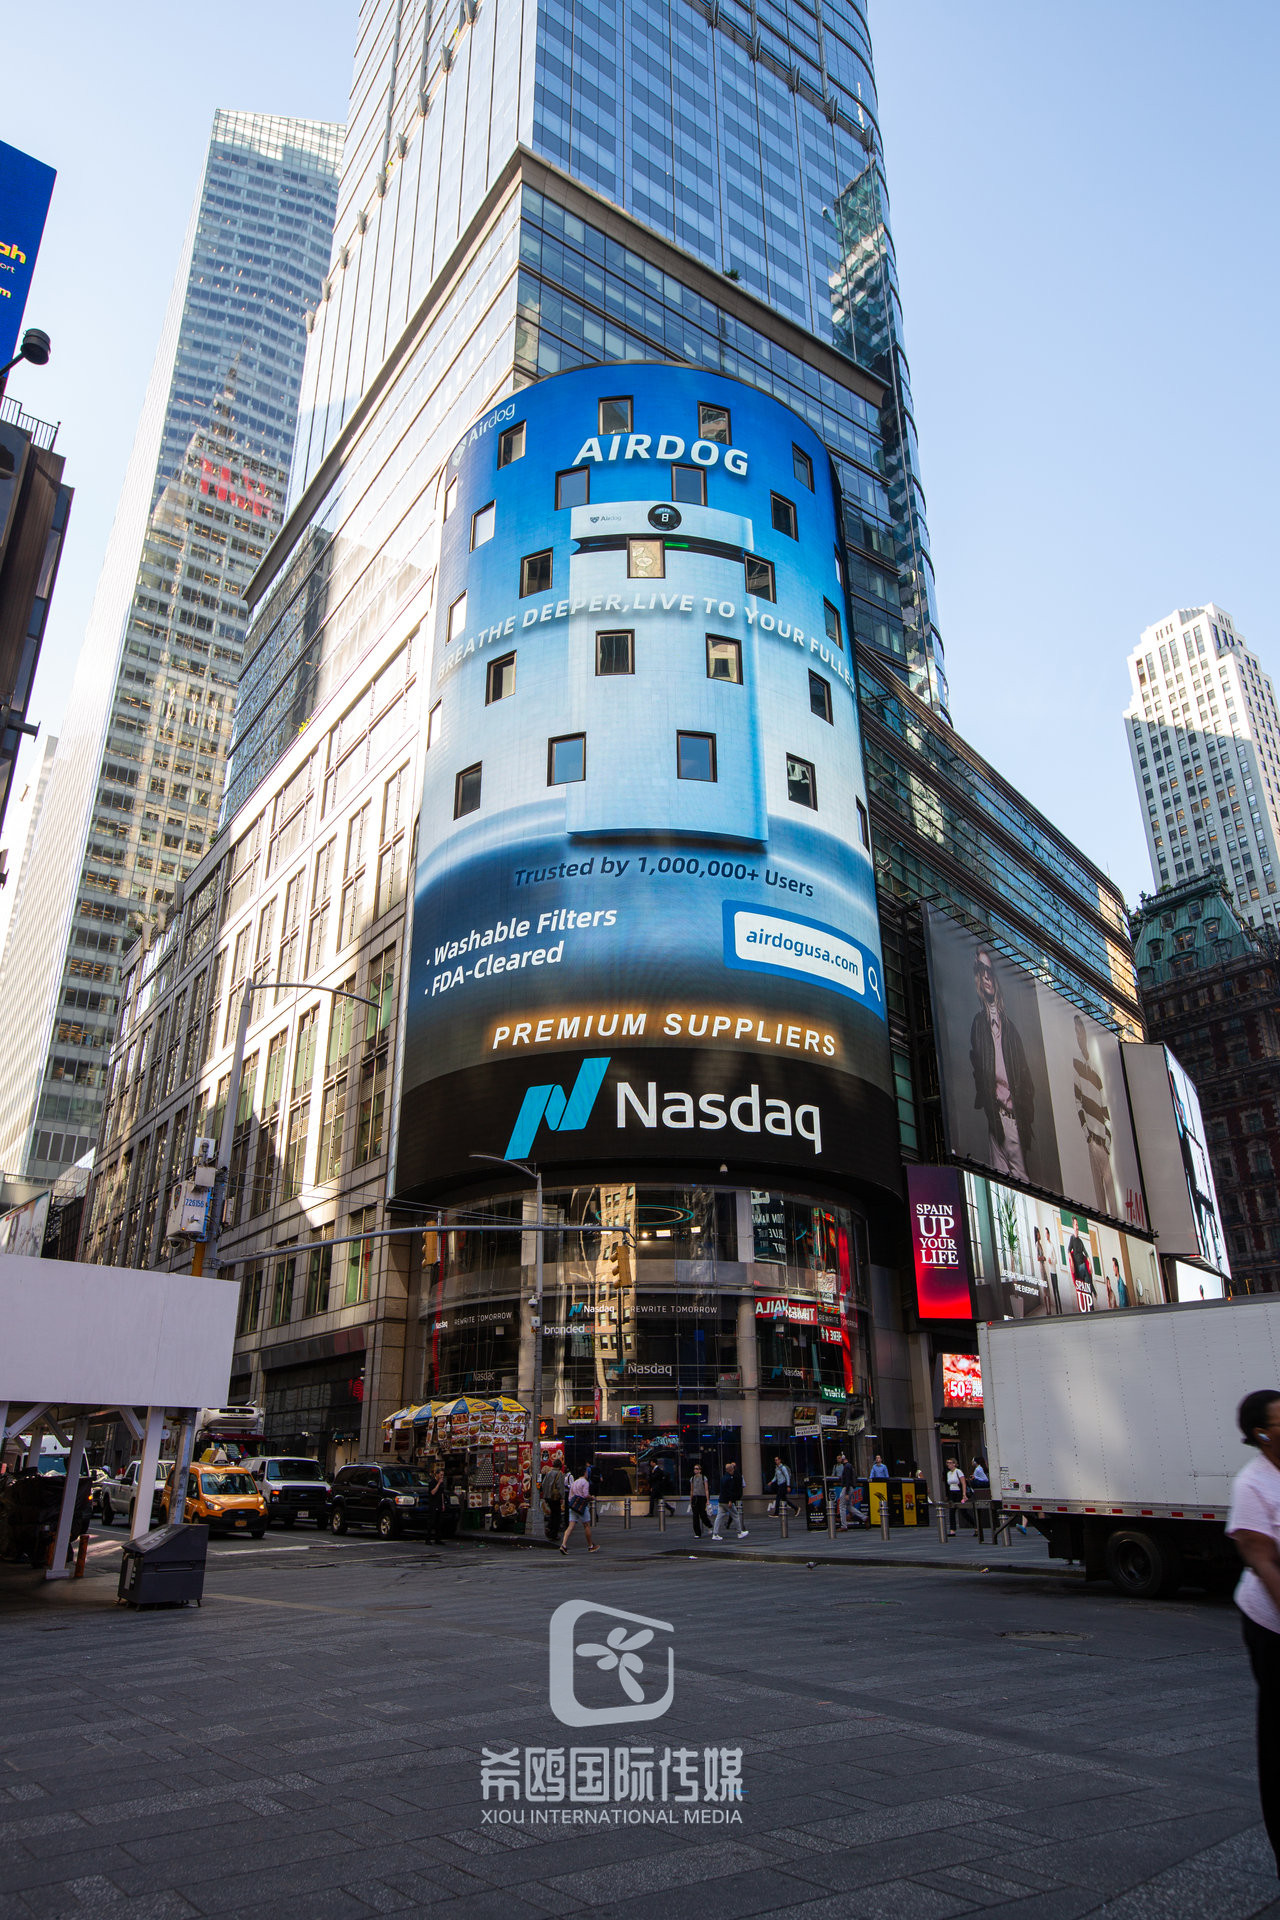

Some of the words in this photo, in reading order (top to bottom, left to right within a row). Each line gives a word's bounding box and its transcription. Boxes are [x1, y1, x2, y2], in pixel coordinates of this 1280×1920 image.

[468, 403, 516, 447] Airdog
[572, 434, 748, 476] AIRDOG
[661, 513, 669, 522] 8
[437, 615, 517, 681] BREATHE
[703, 597, 735, 618] TO
[744, 606, 805, 647] YOUR
[515, 857, 595, 886] Trusted
[600, 856, 630, 877] by
[638, 856, 759, 881] 1,000,000+
[765, 869, 814, 897] Users
[434, 917, 530, 966] Washable
[536, 908, 618, 934] Filters
[746, 928, 859, 976] airdogusa.com
[431, 940, 565, 997] FDA-Cleared
[492, 1013, 647, 1049] PREMIUM
[663, 1013, 836, 1057] SUPPLIERS
[616, 1081, 823, 1155] Nasdaq
[916, 1203, 953, 1215] SPAIN
[917, 1215, 955, 1237] UP
[919, 1237, 957, 1249] YOUR
[920, 1249, 959, 1265] LIFE
[1075, 1280, 1091, 1293] SPAIN
[584, 1304, 615, 1315] Nasdaq
[630, 1305, 667, 1313] REWRITE
[671, 1305, 718, 1314] TOMORROW
[1077, 1292, 1093, 1313] UP
[477, 1312, 513, 1323] TOMORROW
[628, 1363, 672, 1376] Nasdaq
